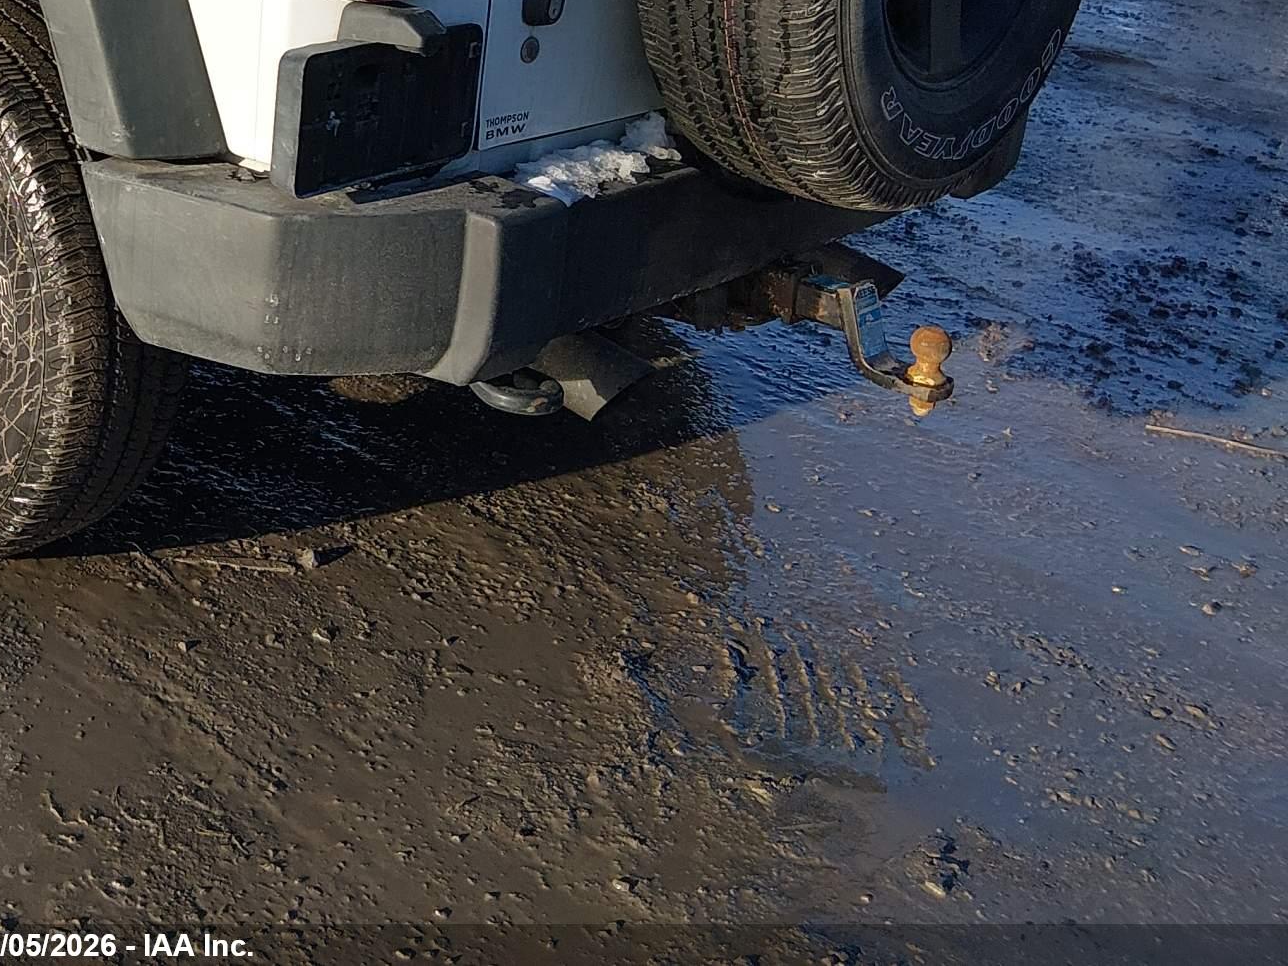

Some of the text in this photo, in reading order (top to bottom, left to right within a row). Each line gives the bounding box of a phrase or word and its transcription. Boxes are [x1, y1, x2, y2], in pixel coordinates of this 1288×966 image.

[880, 29, 1062, 160] GOODYEAR
[486, 112, 530, 129] THOMPSON
[486, 124, 526, 140] BMW
